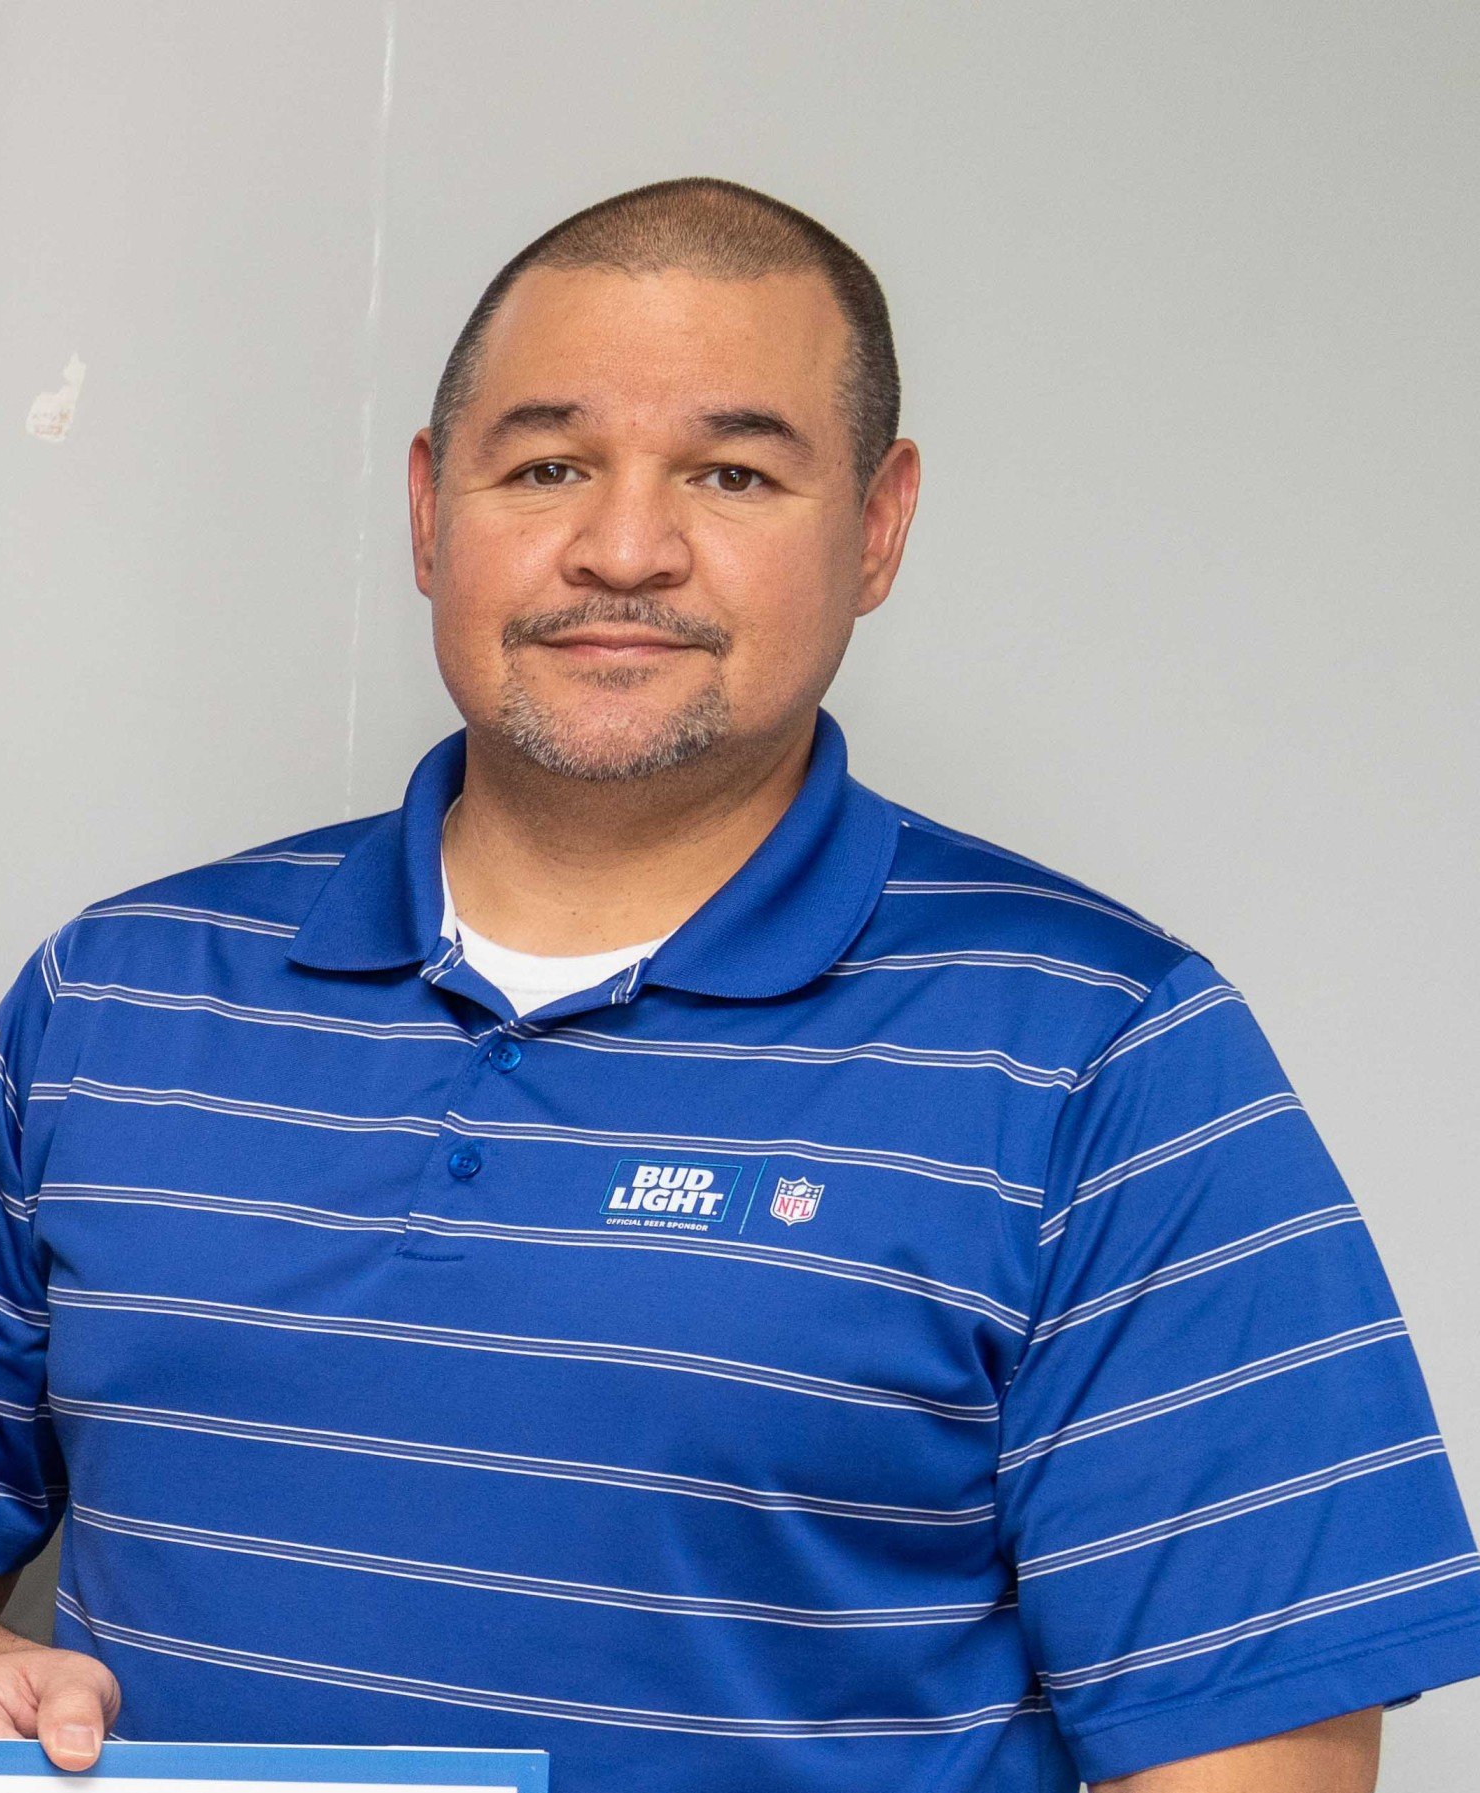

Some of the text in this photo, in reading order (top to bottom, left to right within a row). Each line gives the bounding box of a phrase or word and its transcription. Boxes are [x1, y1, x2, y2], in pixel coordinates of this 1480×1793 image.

[632, 1165, 714, 1191] BUD
[775, 1196, 811, 1218] NFL
[606, 1218, 709, 1232] OFFICIAL BEER SPONSOR
